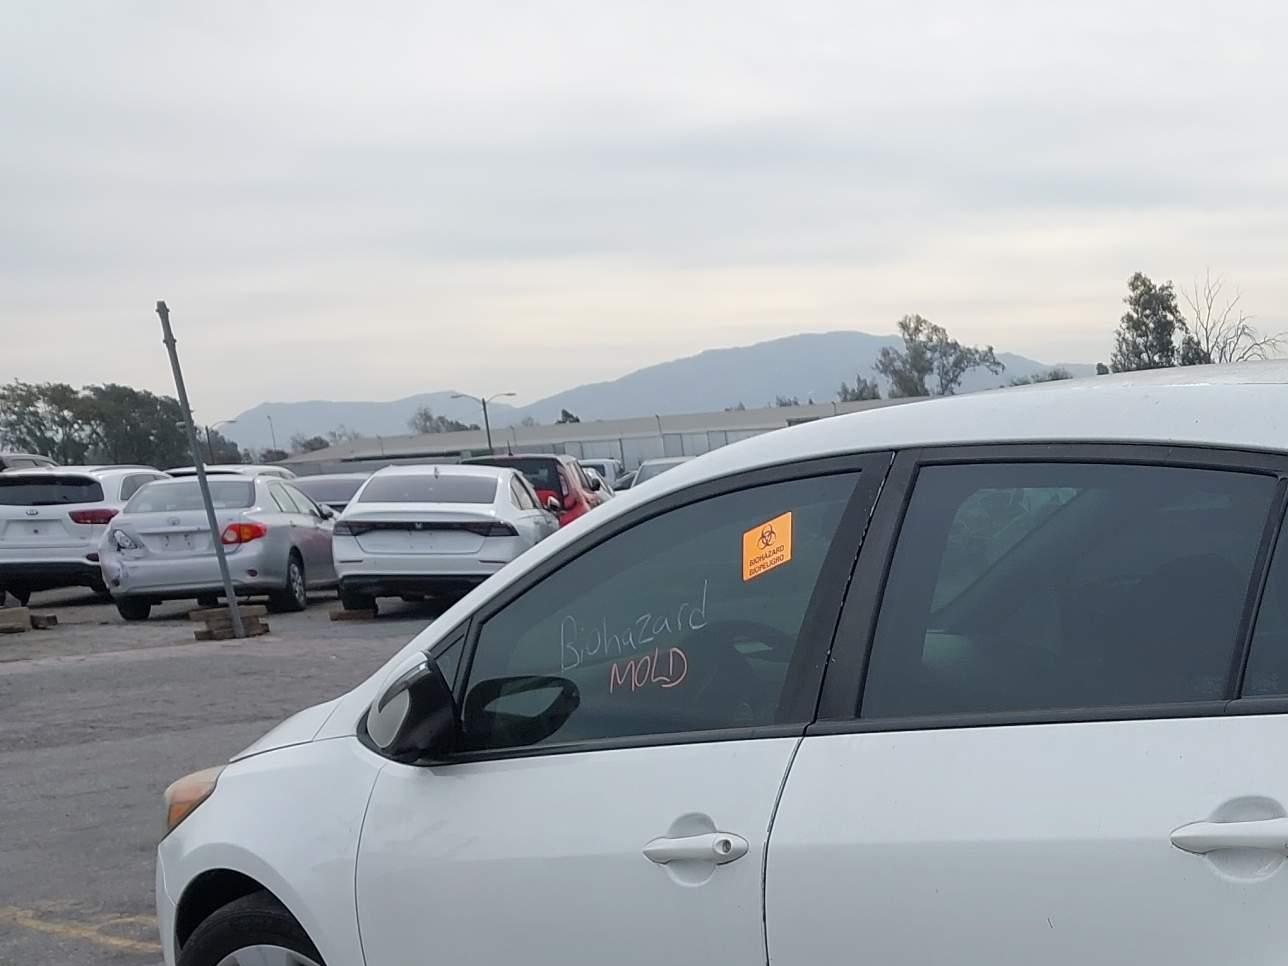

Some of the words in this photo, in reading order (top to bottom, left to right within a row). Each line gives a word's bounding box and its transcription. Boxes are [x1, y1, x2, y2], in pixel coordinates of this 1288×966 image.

[749, 544, 785, 567] BIOHAZARD
[749, 554, 785, 576] BIOPELIGRO
[609, 647, 688, 694] MOLD
